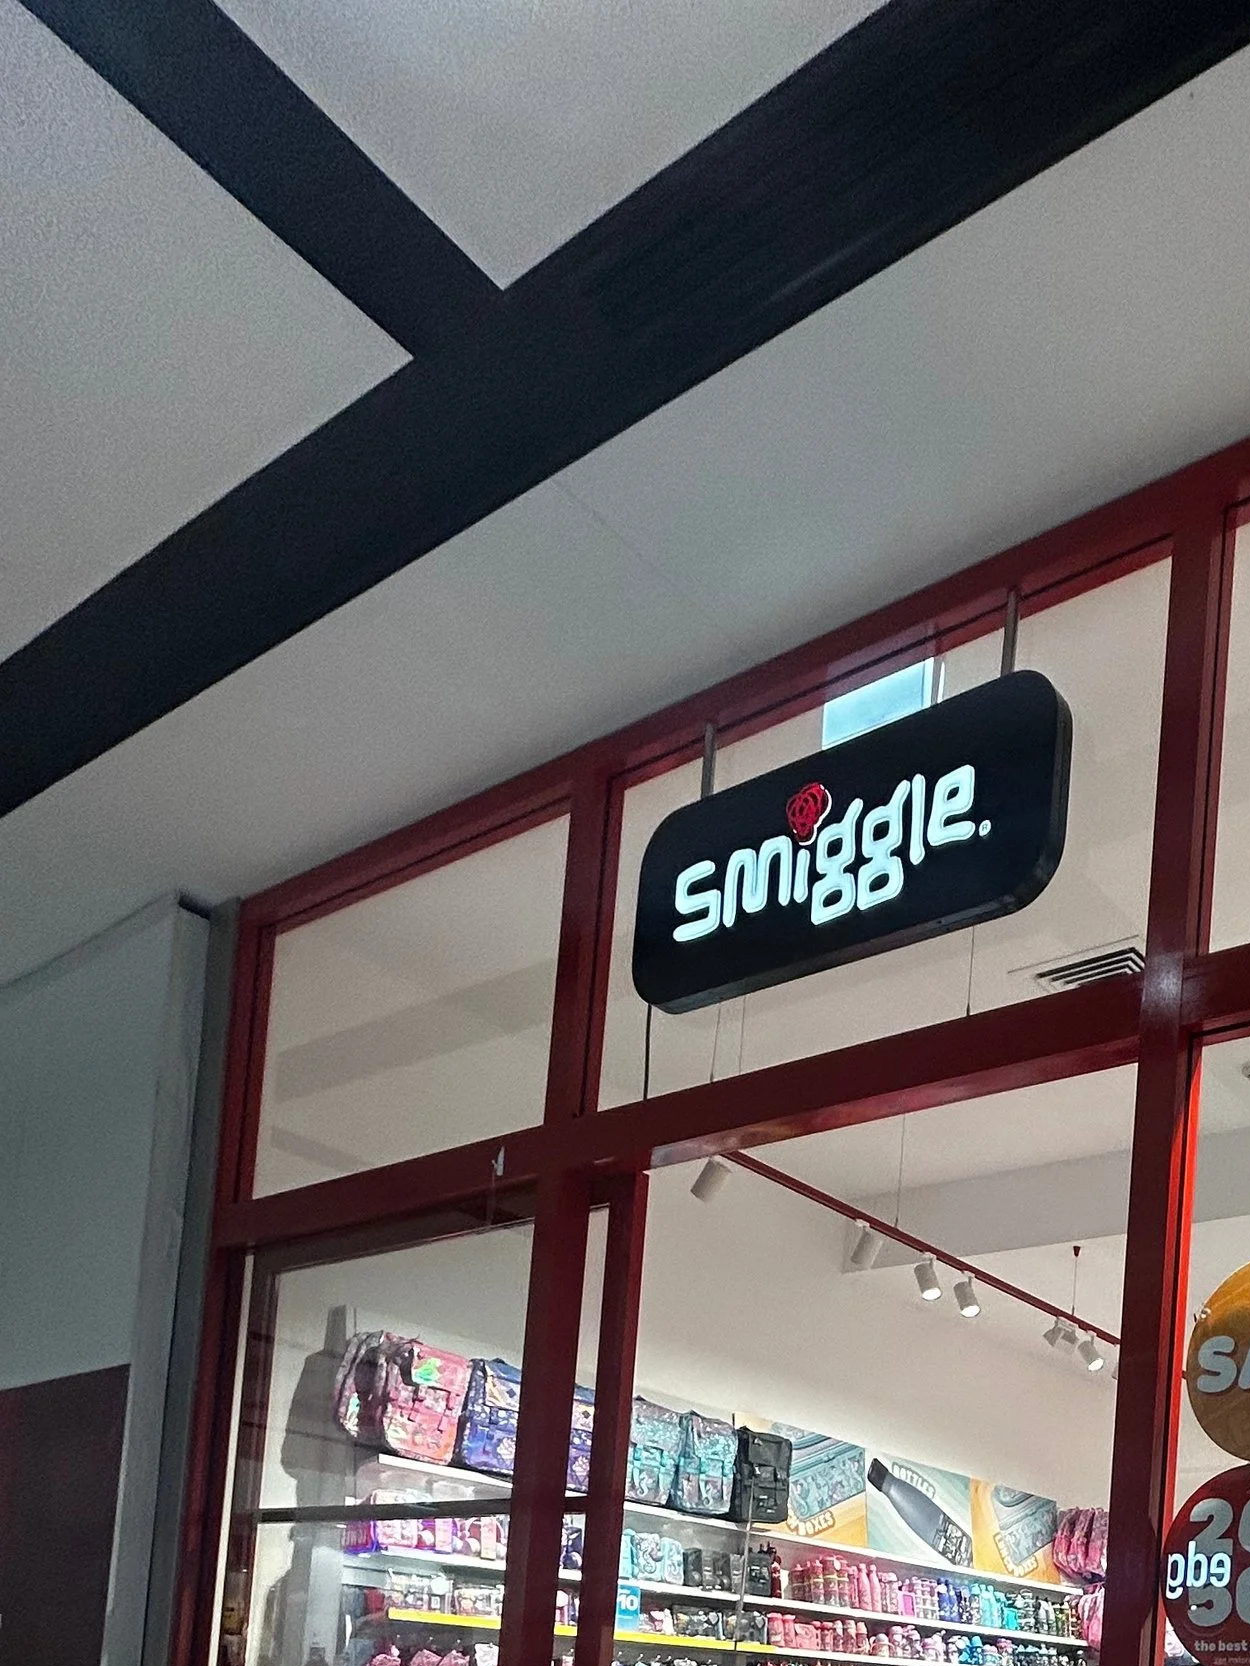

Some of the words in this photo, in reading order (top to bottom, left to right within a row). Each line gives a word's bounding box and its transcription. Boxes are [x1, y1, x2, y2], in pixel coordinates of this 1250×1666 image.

[672, 764, 975, 942] smiggle
[1194, 1640, 1216, 1652] the
[1219, 1640, 1249, 1652] best
